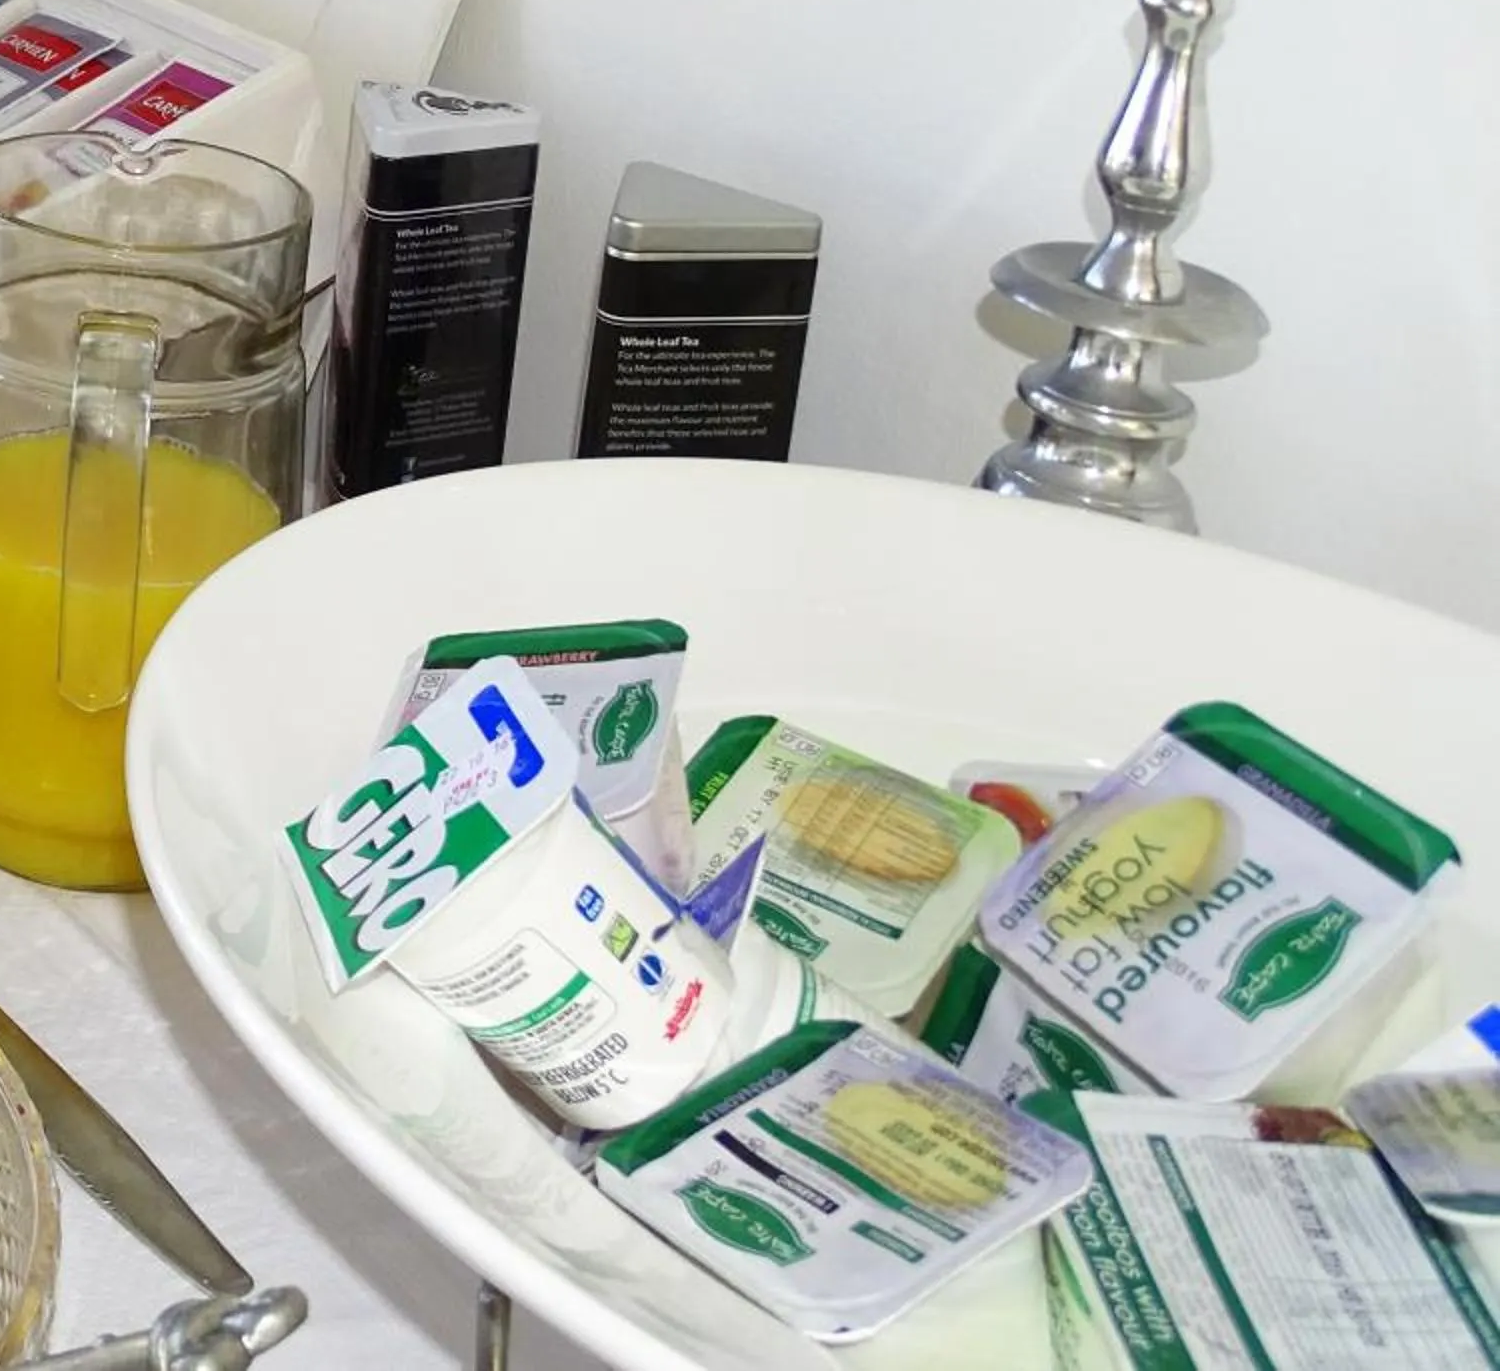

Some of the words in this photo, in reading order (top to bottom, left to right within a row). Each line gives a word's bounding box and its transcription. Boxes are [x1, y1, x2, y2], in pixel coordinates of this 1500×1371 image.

[619, 336, 656, 347] Whole
[657, 335, 681, 347] Leaf
[681, 336, 699, 347] Tea
[516, 650, 598, 668] RAWBERRY
[303, 743, 460, 954] GERO
[998, 837, 1099, 931] SWEETENED
[1026, 834, 1167, 967] yoghurt
[1092, 858, 1275, 1024] flavoured
[1107, 875, 1194, 936] low
[1059, 933, 1122, 994] fat
[1090, 1181, 1142, 1280] rooibos
[1134, 1284, 1175, 1343] with
[1091, 1255, 1156, 1351] flavour
